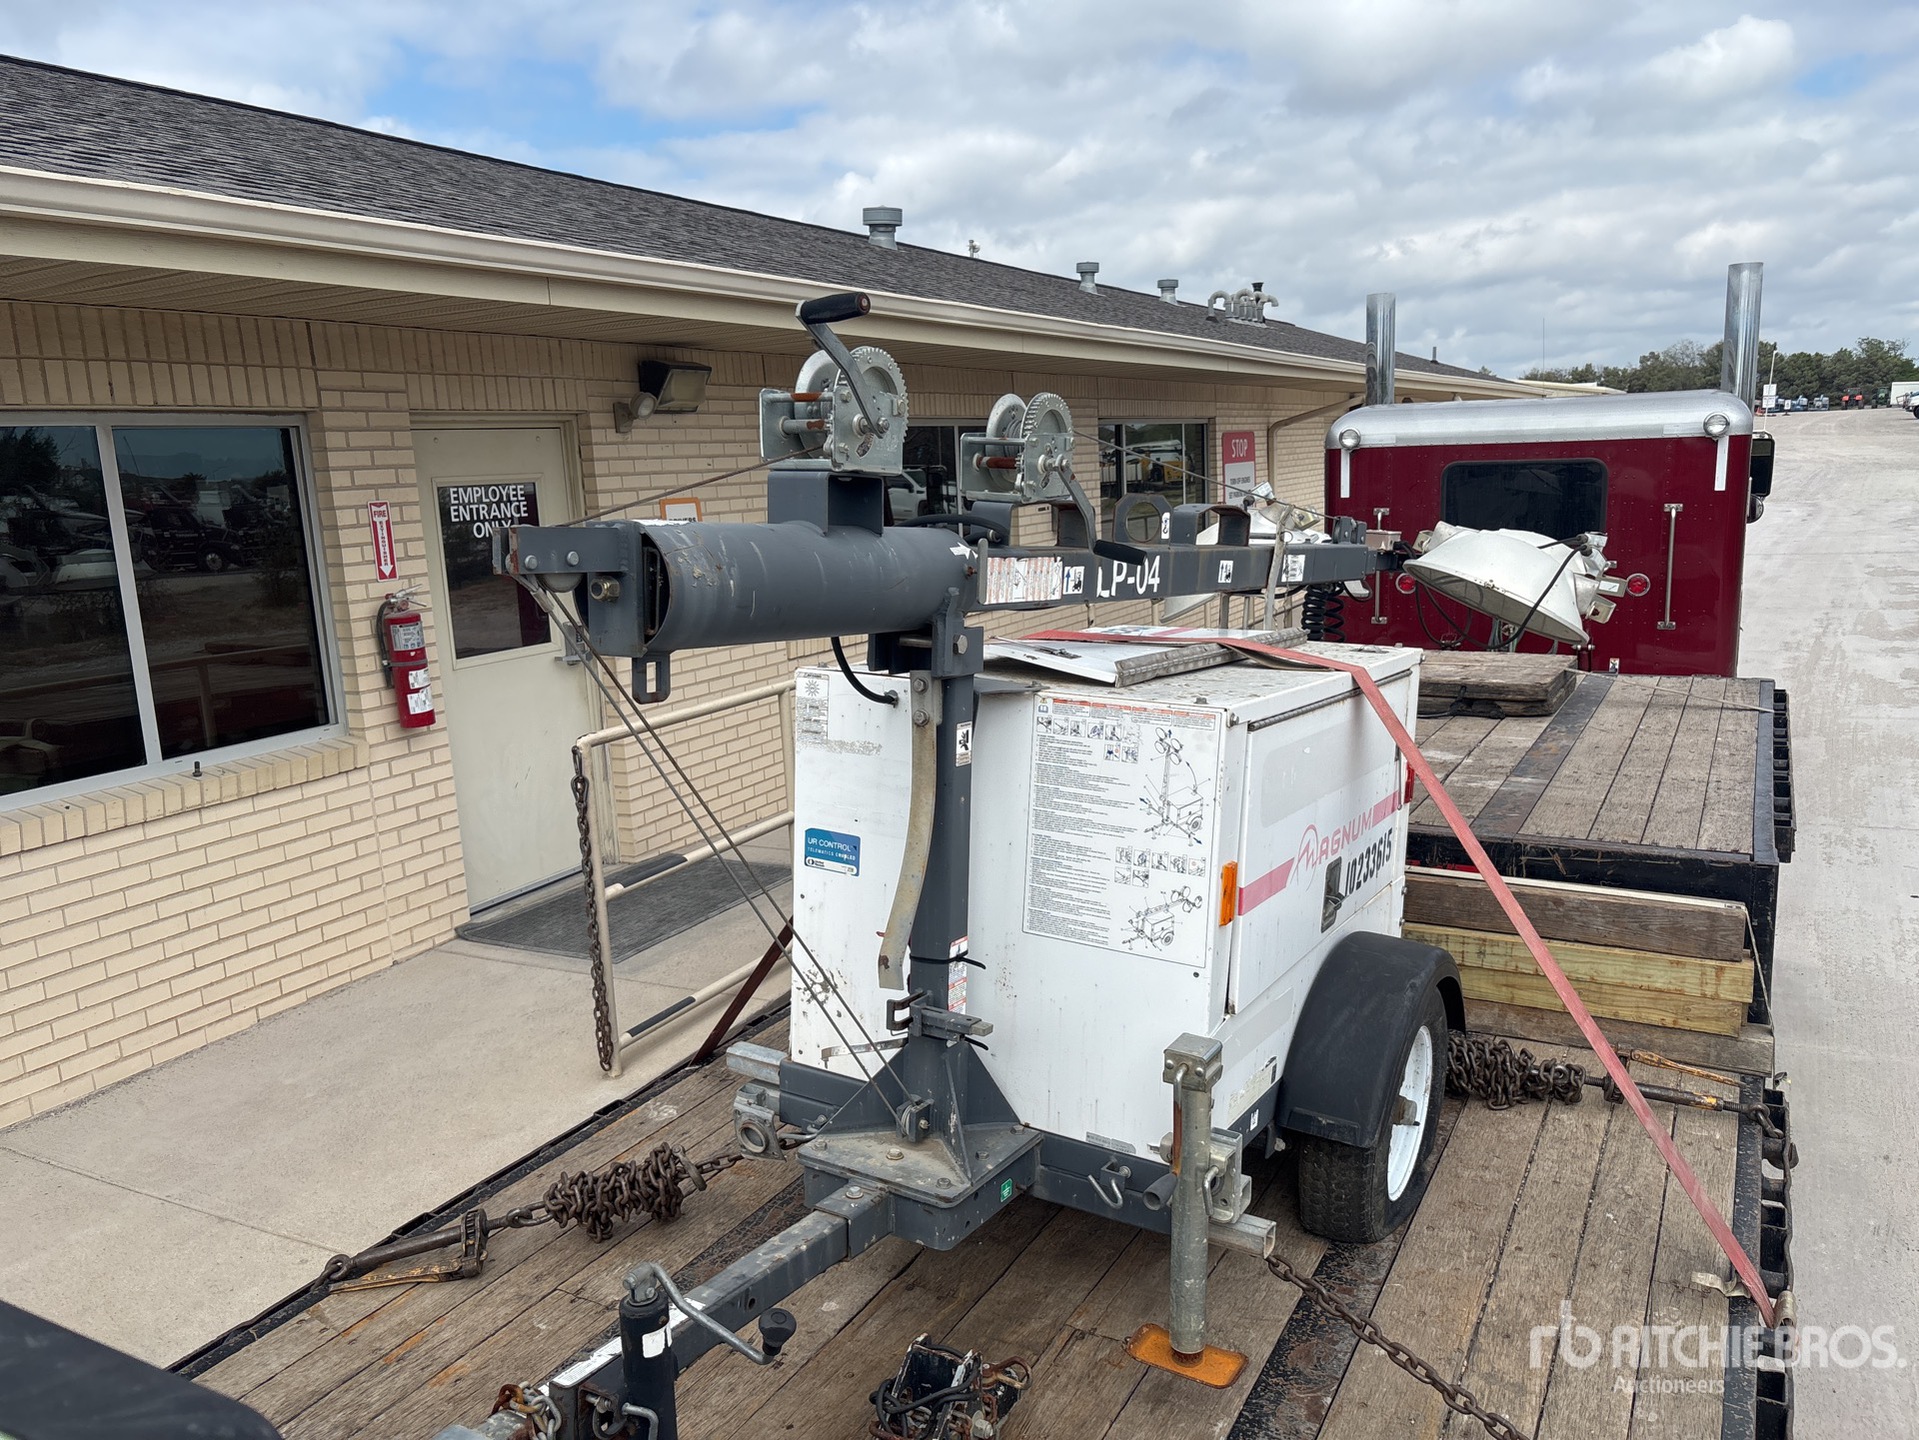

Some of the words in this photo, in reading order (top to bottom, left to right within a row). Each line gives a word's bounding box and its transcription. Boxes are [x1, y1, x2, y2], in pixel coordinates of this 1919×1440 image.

[1231, 438, 1248, 458] STOP
[449, 485, 526, 504] EMPLOYEE
[373, 510, 387, 518] FIRE
[450, 501, 529, 523] ENTRANCE
[379, 520, 389, 567] EXTINGUISHER
[1096, 555, 1160, 598] LP-04
[807, 837, 818, 846] UR
[818, 839, 852, 852] CONTROL
[1296, 807, 1373, 873] MAGNUM
[1345, 827, 1393, 897] 10233615
